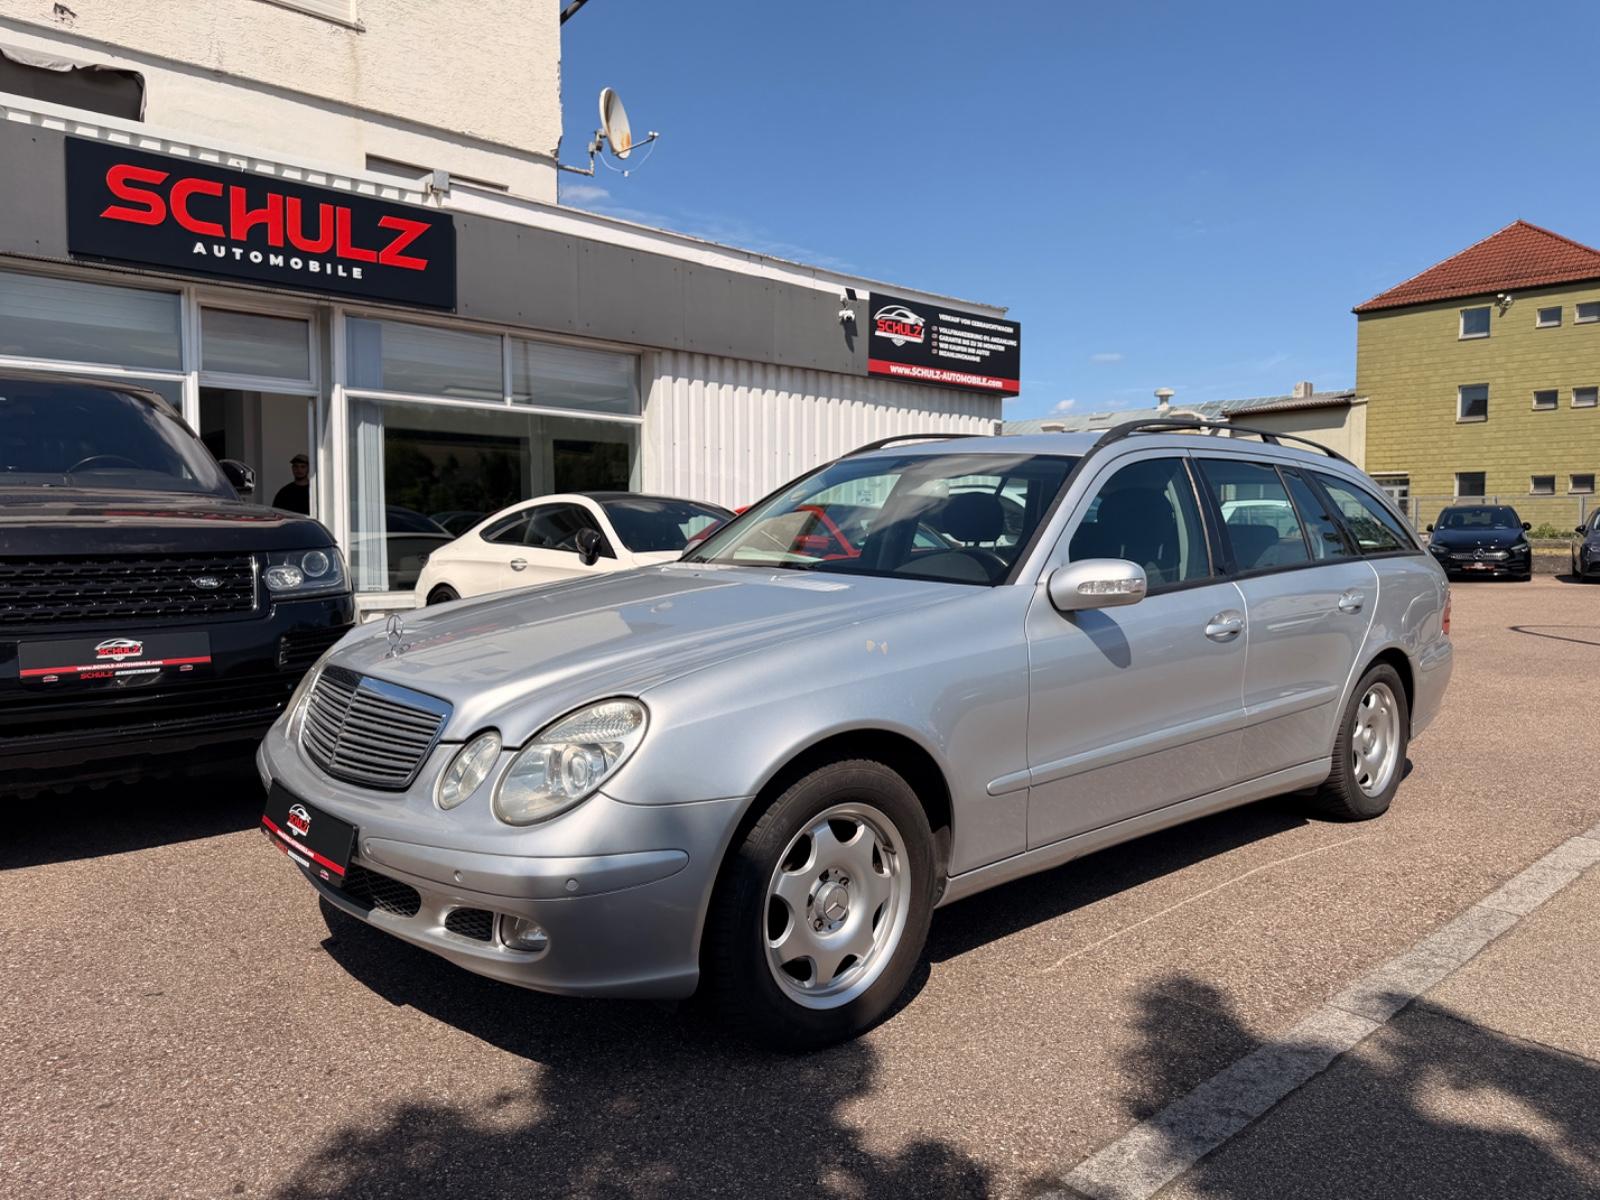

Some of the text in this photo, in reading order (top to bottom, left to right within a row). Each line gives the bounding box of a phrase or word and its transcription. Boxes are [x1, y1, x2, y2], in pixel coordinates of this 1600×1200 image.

[100, 164, 432, 271] SCHULZ
[193, 241, 363, 279] AUTOMOBILE
[876, 319, 922, 338] SCHULZ
[939, 313, 1014, 333] VERKAUF VON GEBRAUCHTWAGEN
[939, 334, 961, 344] GARANTIE
[983, 342, 1005, 352] MONATEN
[949, 343, 968, 353] KAUFEN
[889, 365, 1003, 388] www.SCHULZ-AUTOMOBILE.com
[98, 644, 140, 656] SCHULZ
